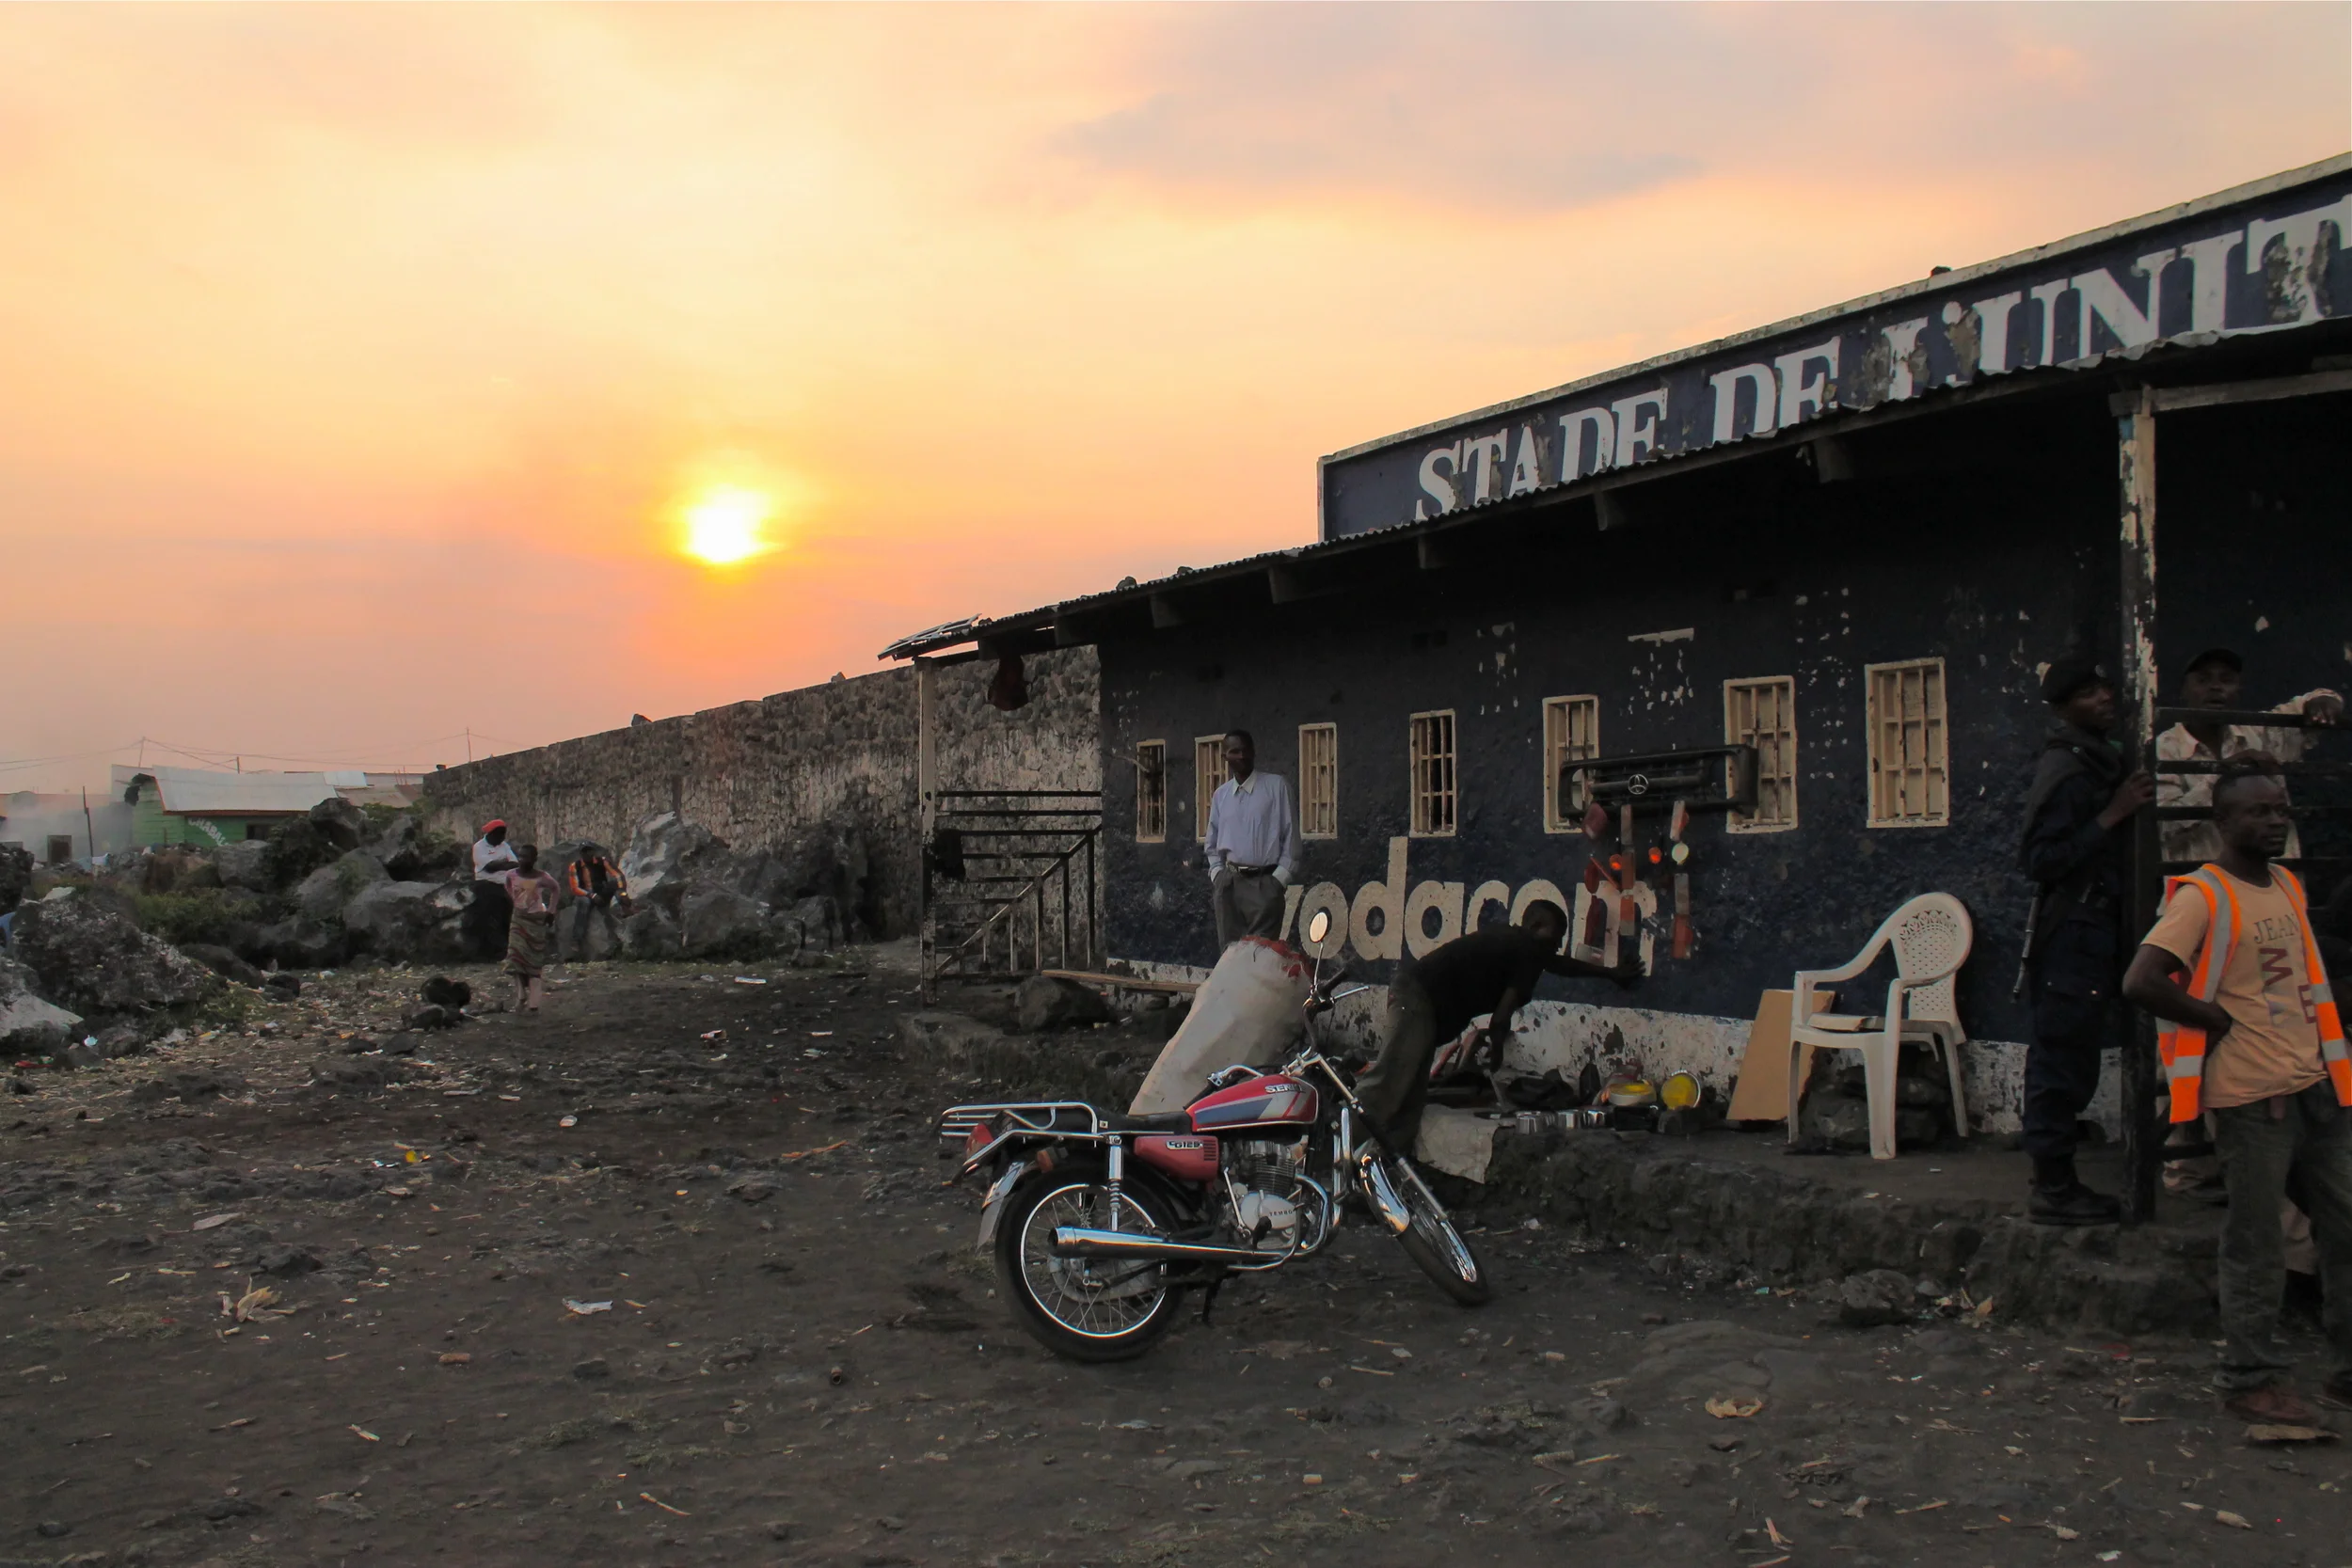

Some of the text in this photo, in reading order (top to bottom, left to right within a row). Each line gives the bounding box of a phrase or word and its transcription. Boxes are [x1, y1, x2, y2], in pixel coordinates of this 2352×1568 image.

[1415, 388, 1669, 521] STADE
[1709, 336, 1841, 446] DE
[1268, 1209, 1294, 1217] TEMBO
